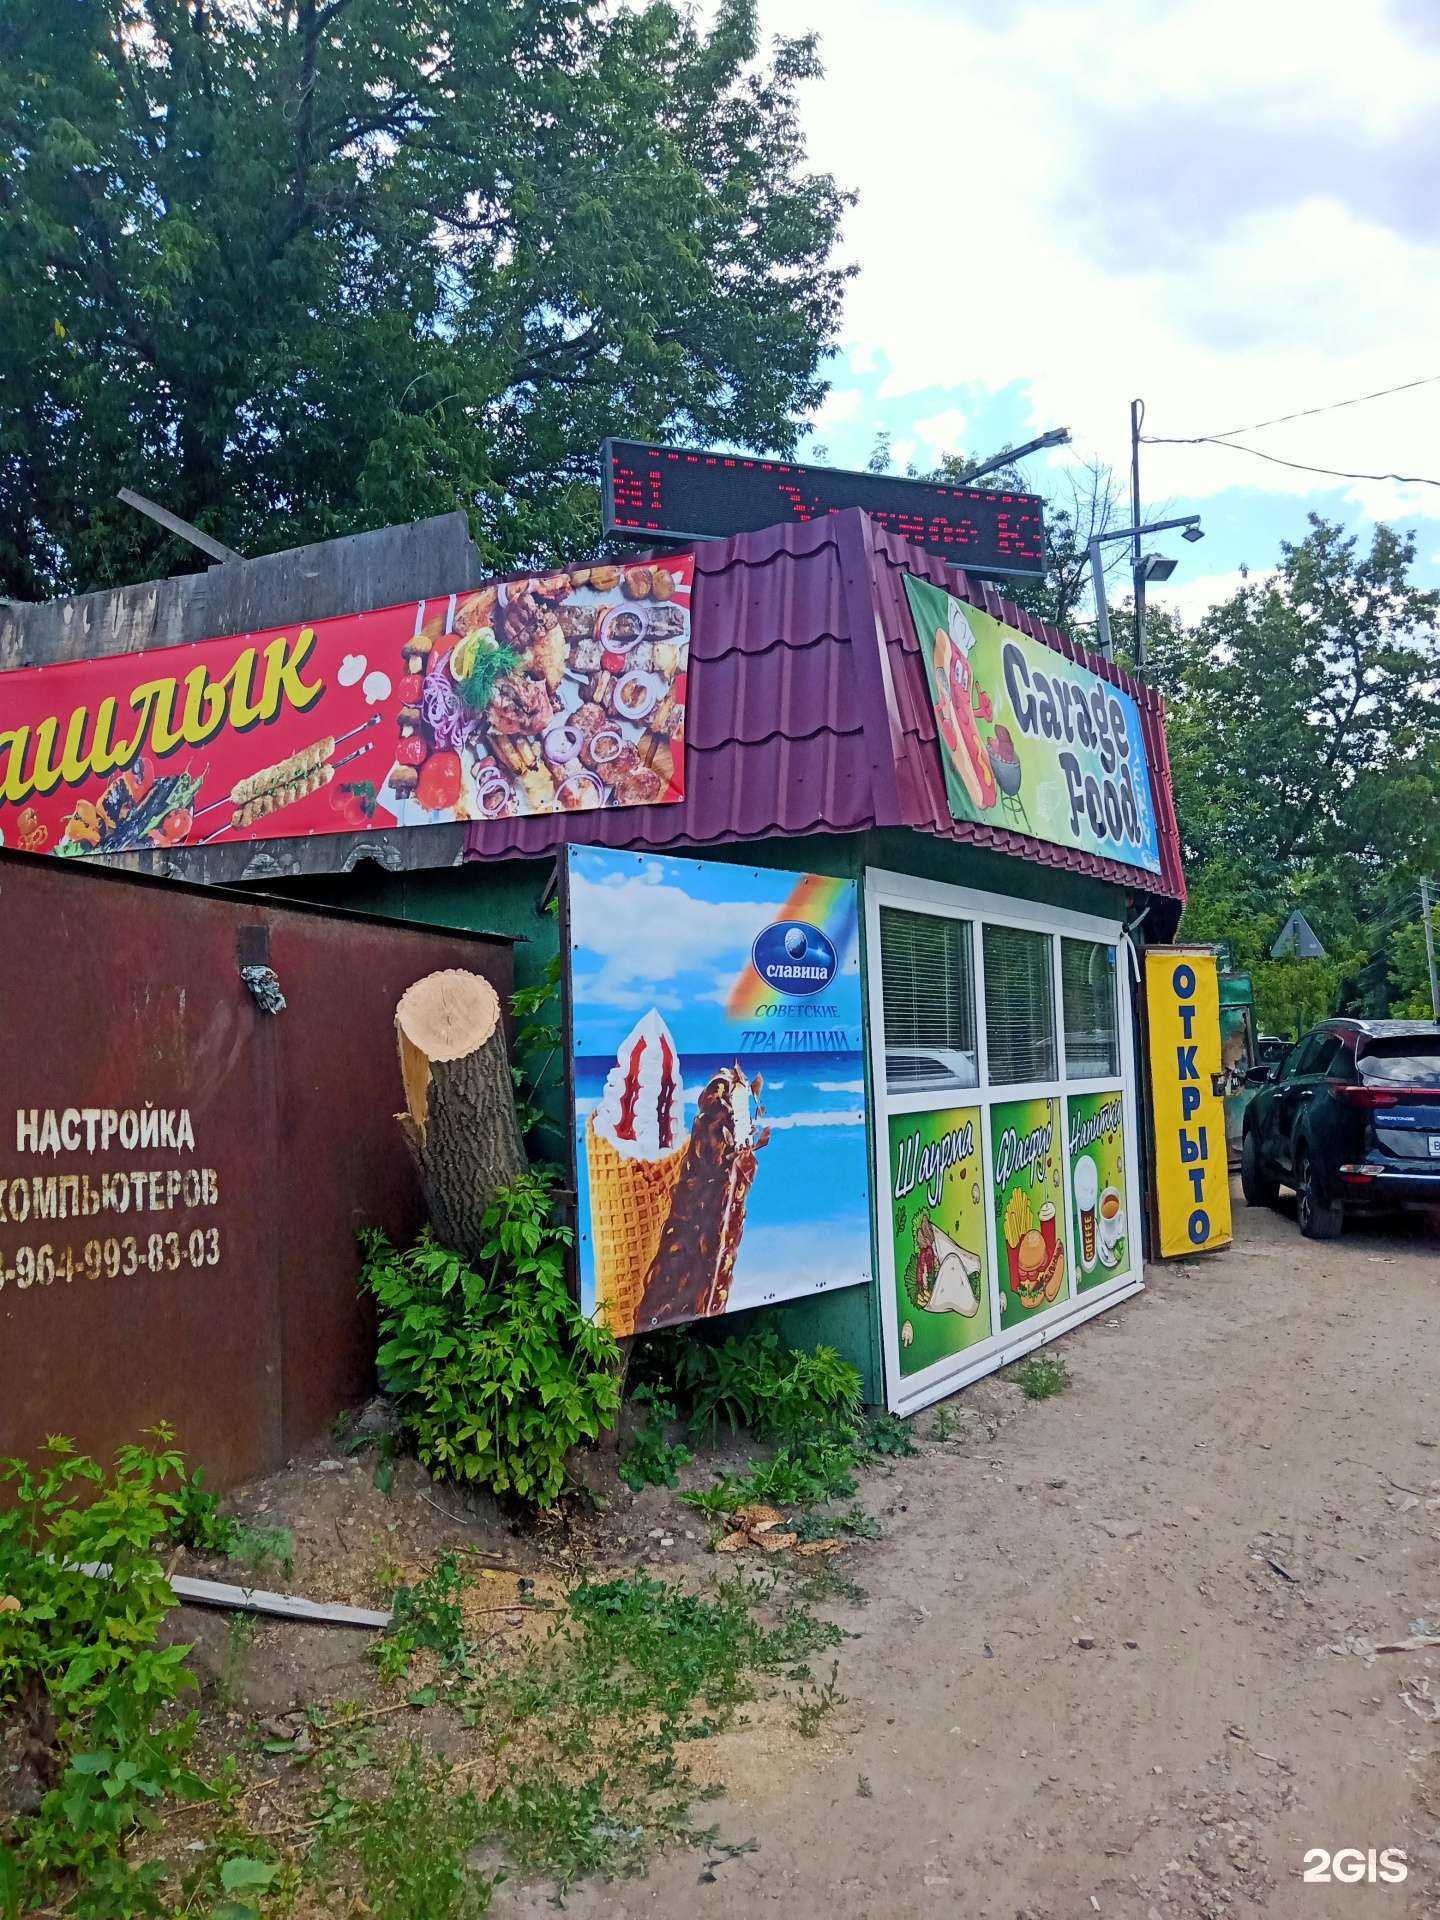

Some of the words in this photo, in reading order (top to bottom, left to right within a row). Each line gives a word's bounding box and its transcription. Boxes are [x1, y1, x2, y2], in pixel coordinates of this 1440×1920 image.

[1003, 643, 1129, 774] Garage
[1059, 752, 1141, 844] Food
[766, 964, 828, 980] славица
[754, 1004, 841, 1018] СОВЕТСКИЕ
[16, 1100, 196, 1155] НАСТРОЙКА
[1172, 963, 1210, 1245] ОТКРЫТО
[895, 1121, 974, 1208] Шаурма
[0, 1227, 221, 1291] -964-993-83-03
